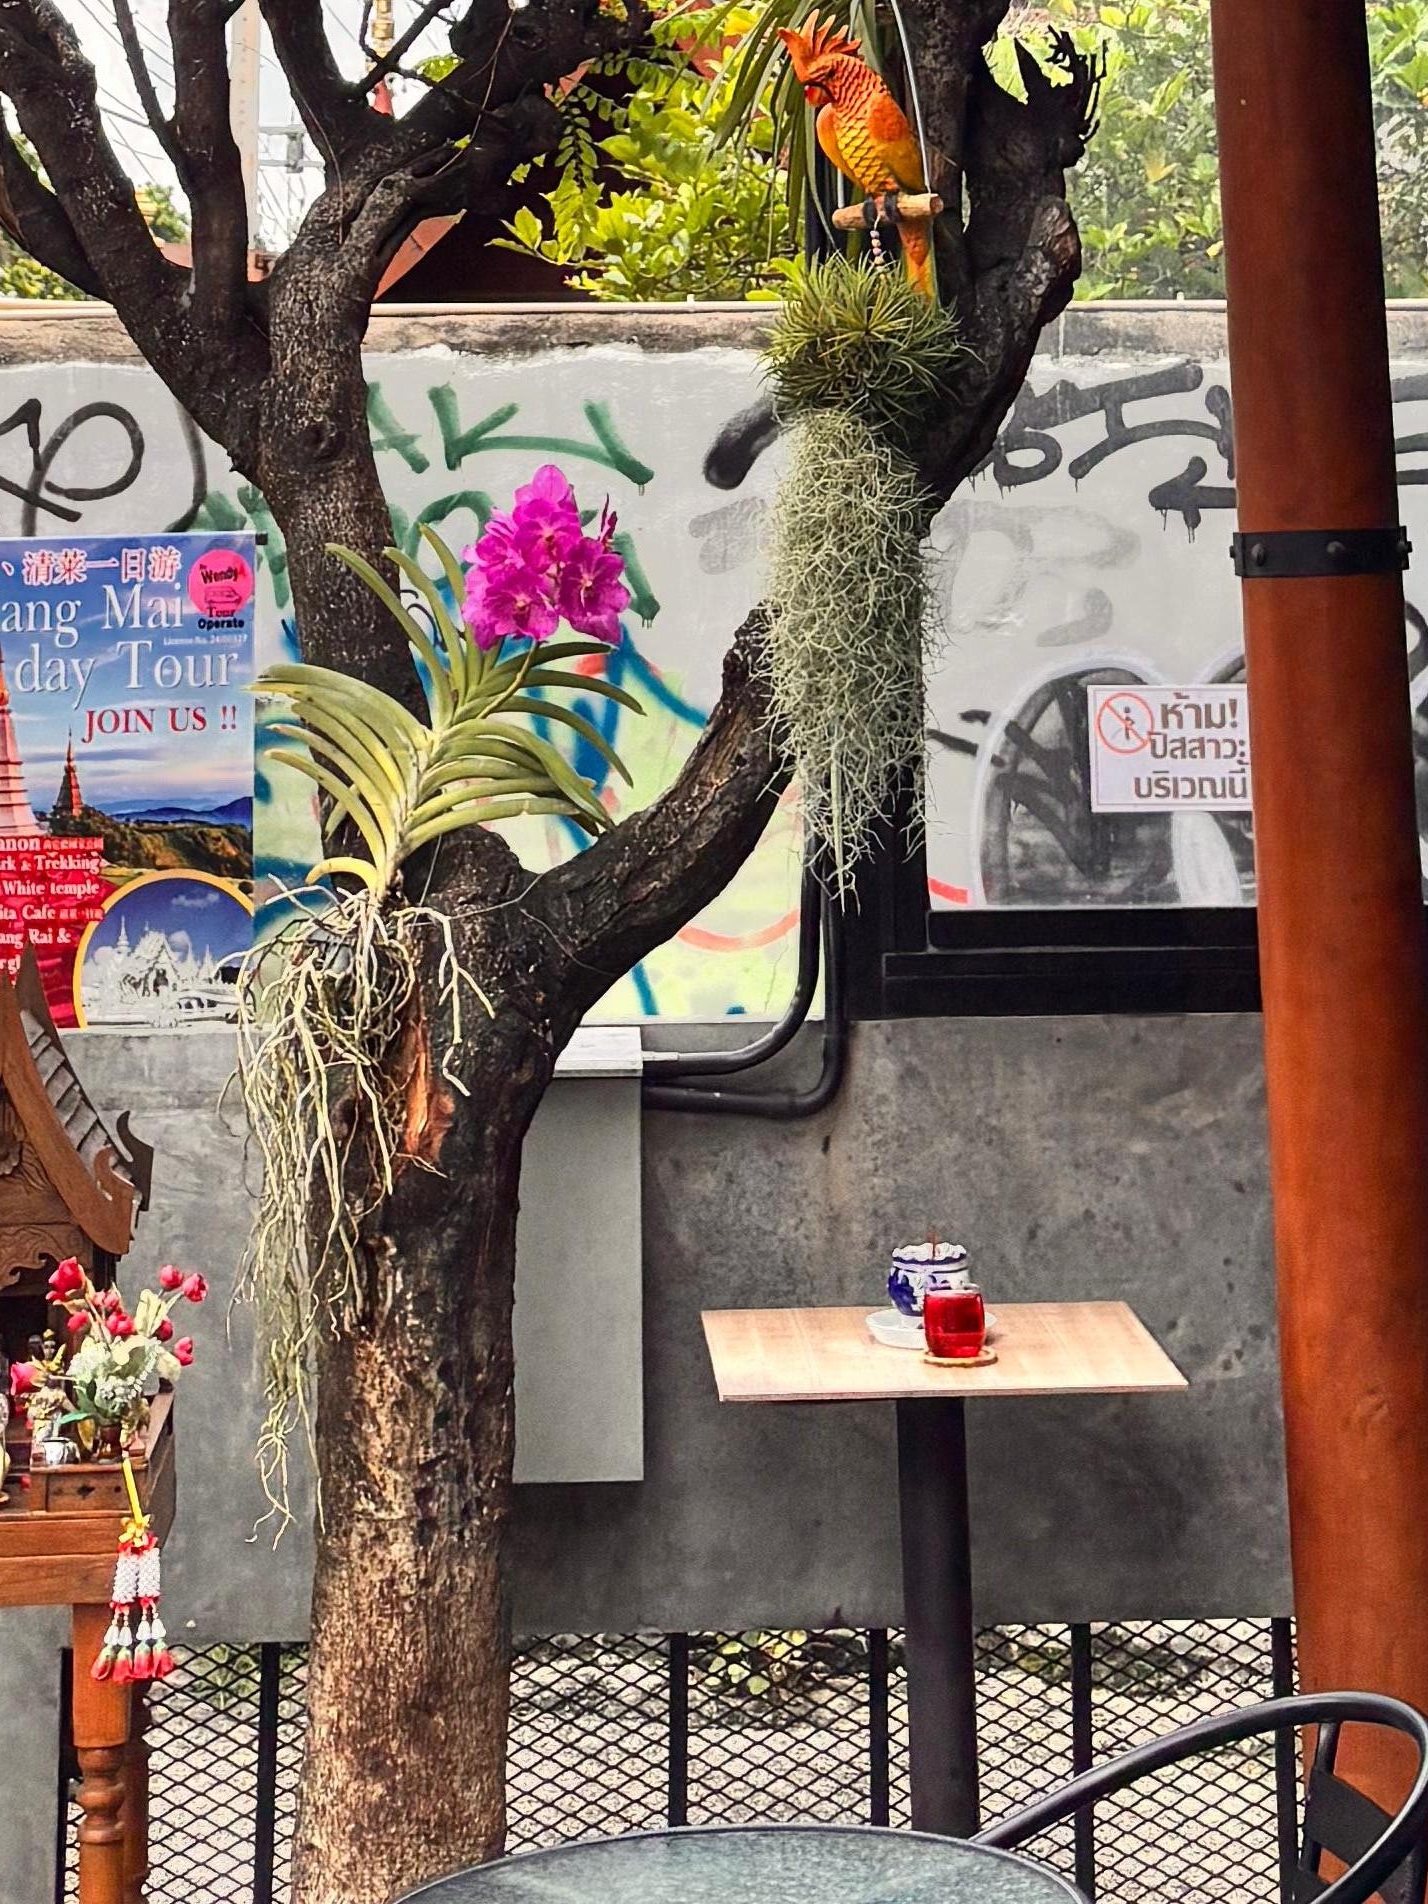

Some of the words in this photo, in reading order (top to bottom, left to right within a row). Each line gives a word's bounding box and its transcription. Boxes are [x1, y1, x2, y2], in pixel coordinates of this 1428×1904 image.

[102, 582, 184, 630] Mai
[198, 617, 245, 630] Operate
[14, 643, 97, 711] day
[117, 640, 239, 689] Tour
[82, 707, 156, 744] JOIN
[168, 706, 208, 733] US
[220, 705, 238, 731] !!
[1160, 692, 1238, 730] ห้าม!
[1134, 759, 1250, 799] บริเวณนี้
[34, 854, 101, 875] Trekking
[2, 880, 46, 896] White
[50, 880, 100, 899] temple
[22, 904, 56, 921] Cafe
[28, 927, 53, 944] Rai
[56, 927, 72, 944] &
